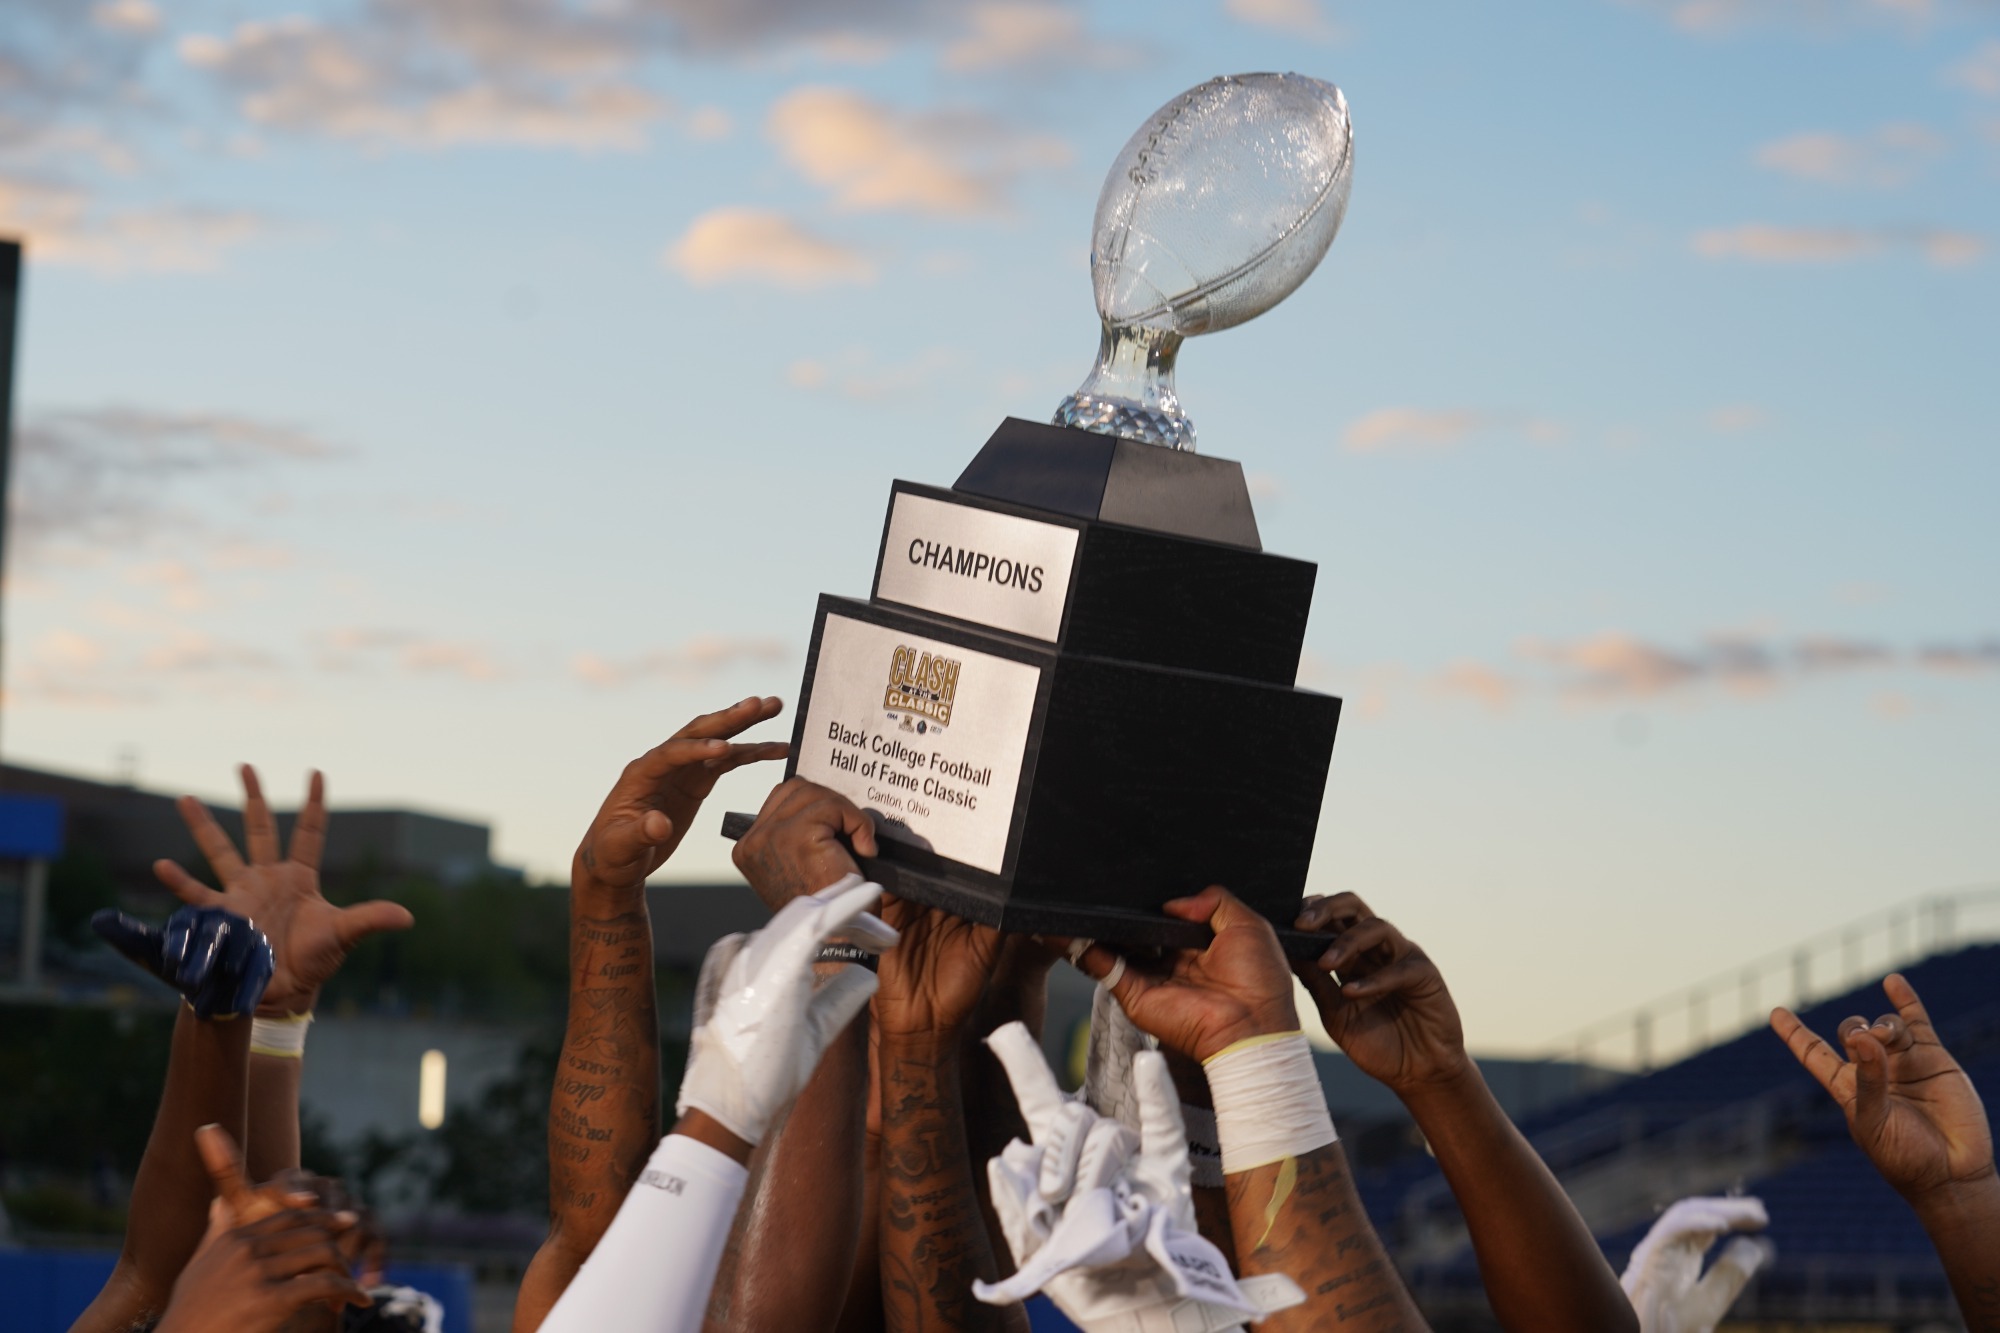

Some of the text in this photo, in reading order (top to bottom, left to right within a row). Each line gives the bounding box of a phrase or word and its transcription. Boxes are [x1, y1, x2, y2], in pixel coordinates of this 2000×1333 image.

[908, 538, 1045, 593] CHAMPIONS
[888, 645, 961, 705] CLASH
[888, 691, 948, 722] CLASSIC
[828, 721, 869, 749] Black
[872, 735, 926, 769] College
[929, 752, 992, 787] Football
[830, 748, 978, 810] Hall of Fame Classic
[867, 786, 930, 818] Canton, Ohio
[576, 1058, 621, 1076] MARK
[586, 1128, 613, 1142] FOR
